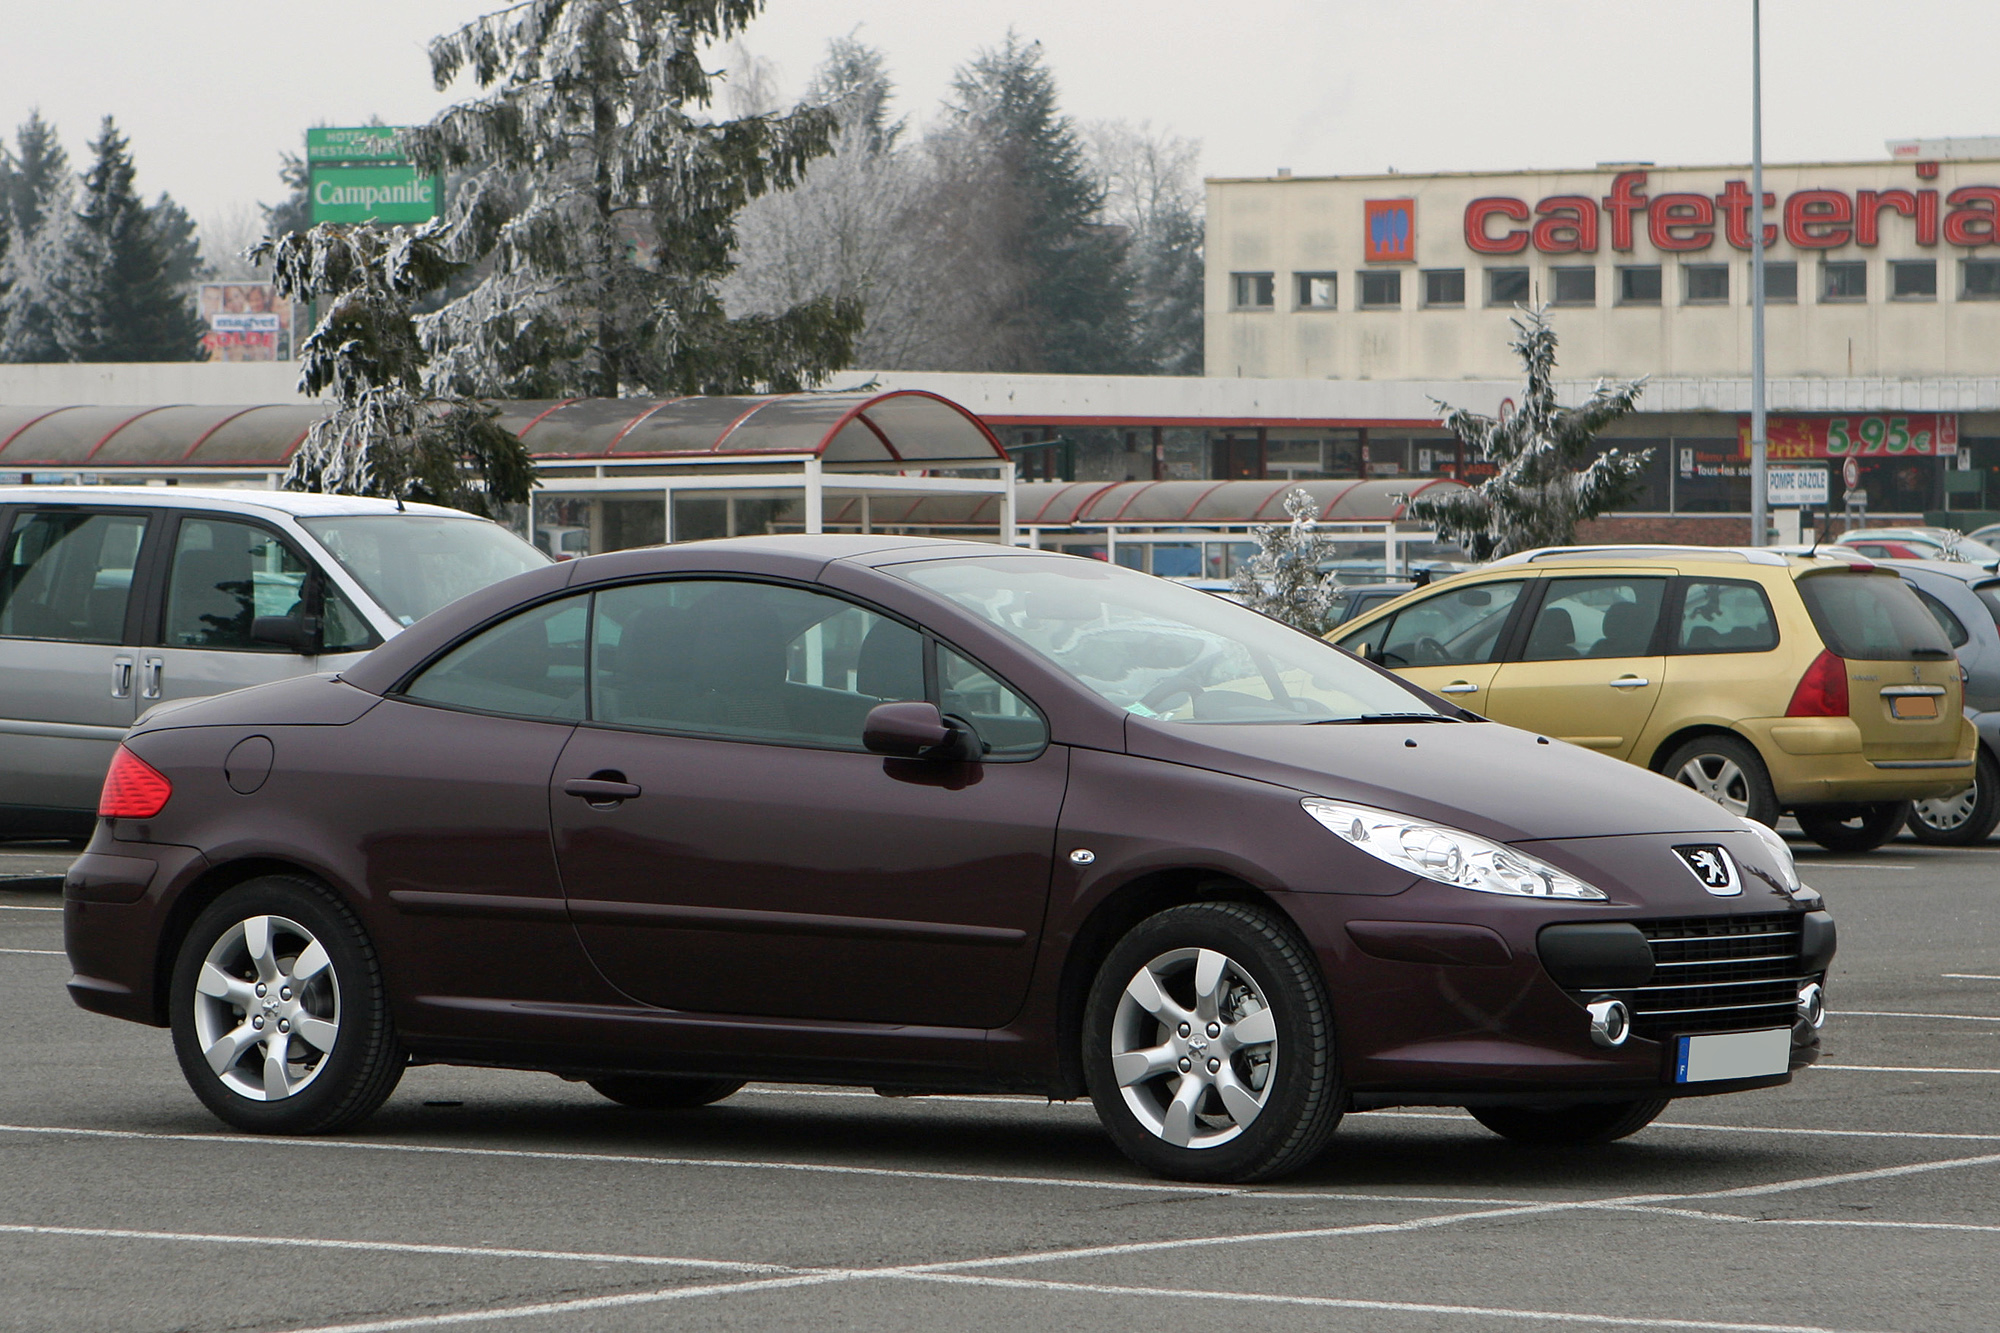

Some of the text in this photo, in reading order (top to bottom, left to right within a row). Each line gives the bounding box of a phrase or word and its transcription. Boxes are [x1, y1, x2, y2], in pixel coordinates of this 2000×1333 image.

[315, 180, 432, 210] Campanile
[1463, 161, 2000, 256] cafeteria
[1770, 471, 1826, 489] POMPE GAZOLE
